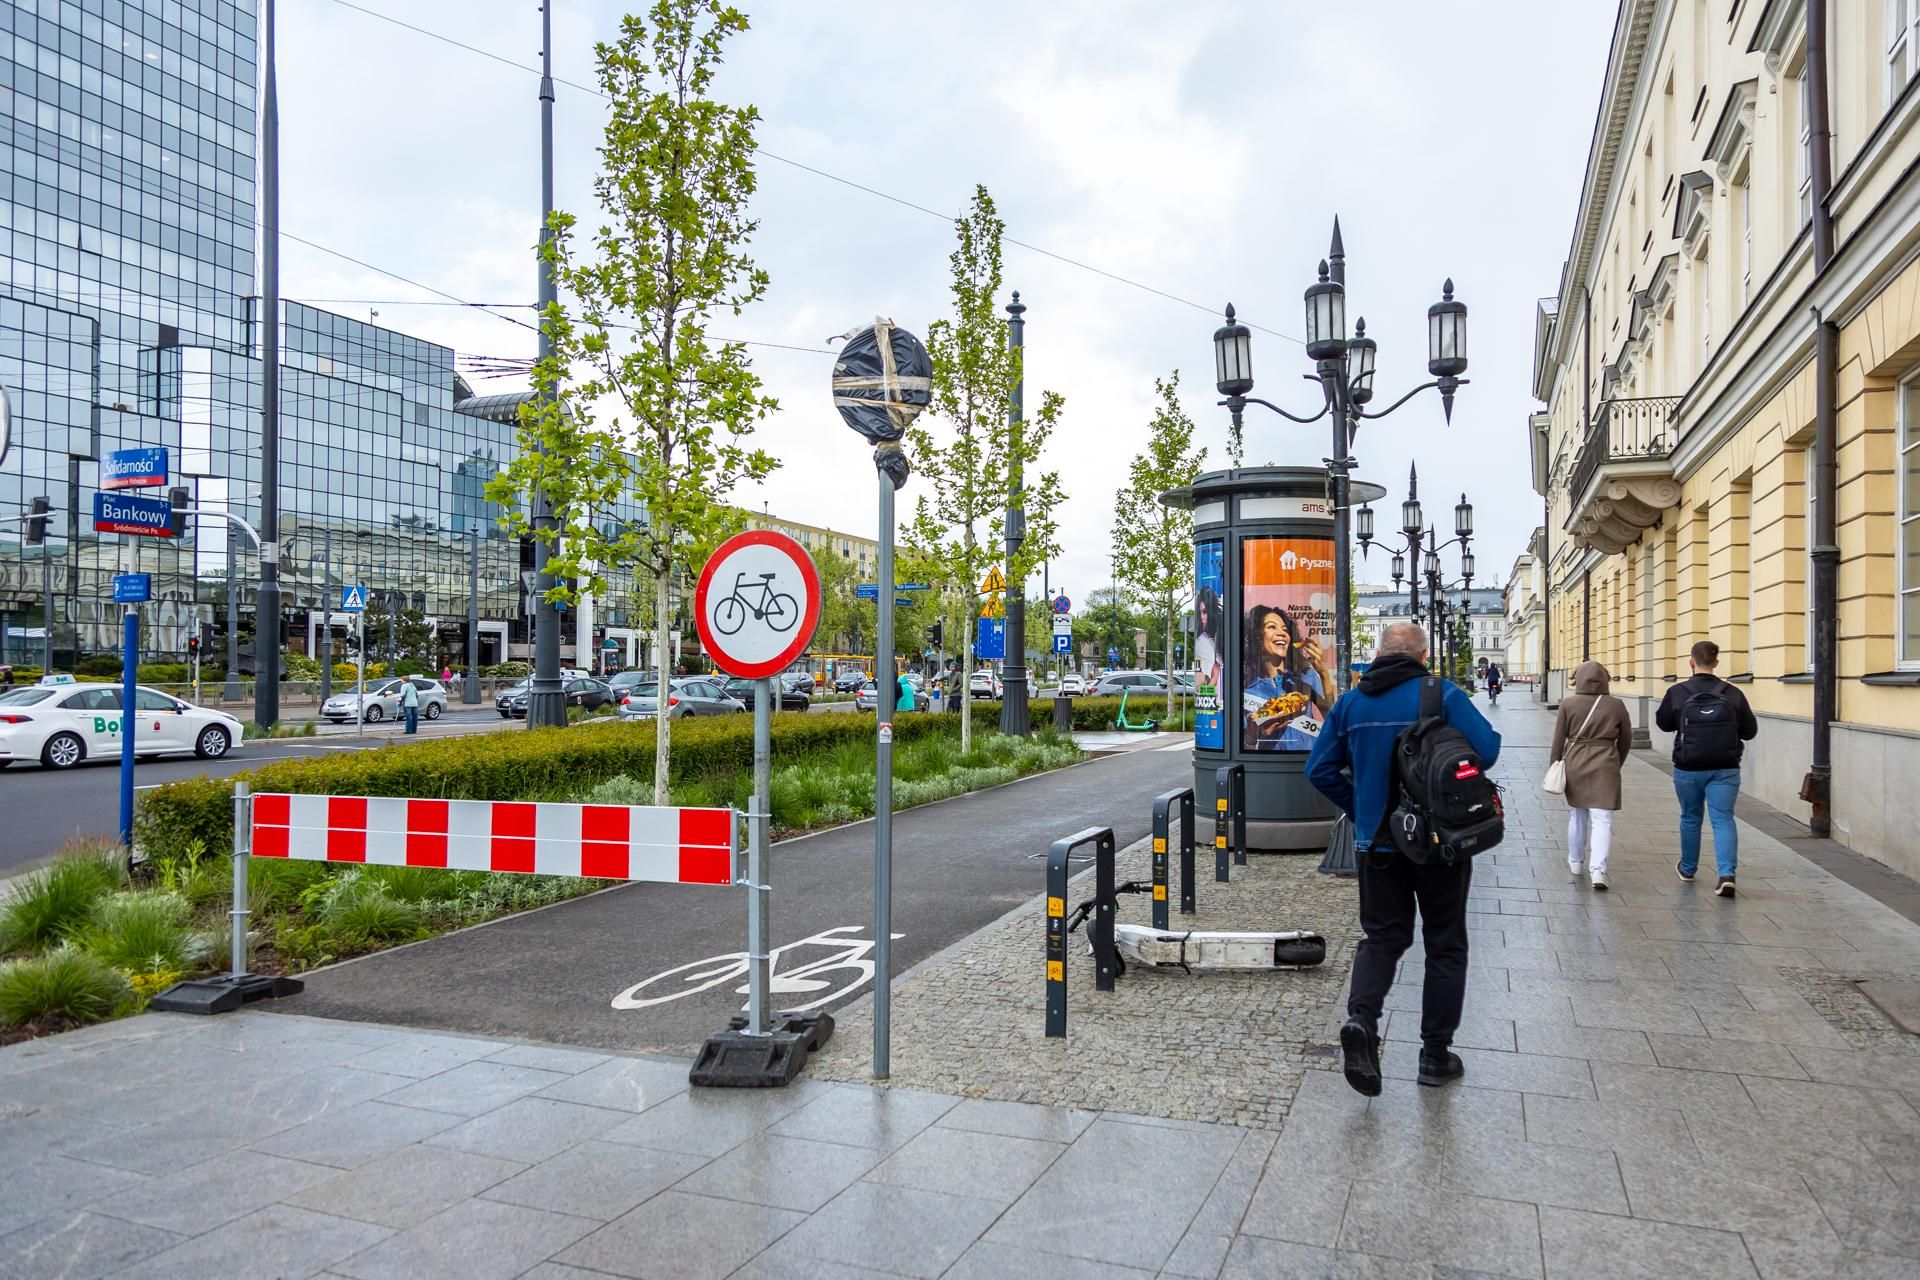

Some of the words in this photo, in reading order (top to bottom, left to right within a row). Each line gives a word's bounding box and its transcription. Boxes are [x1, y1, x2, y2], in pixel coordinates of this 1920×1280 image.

[1301, 503, 1325, 513] ams
[103, 503, 167, 528] Bankowy
[113, 523, 150, 534] Śródmieście
[1308, 627, 1336, 637] preze
[1057, 637, 1068, 651] P
